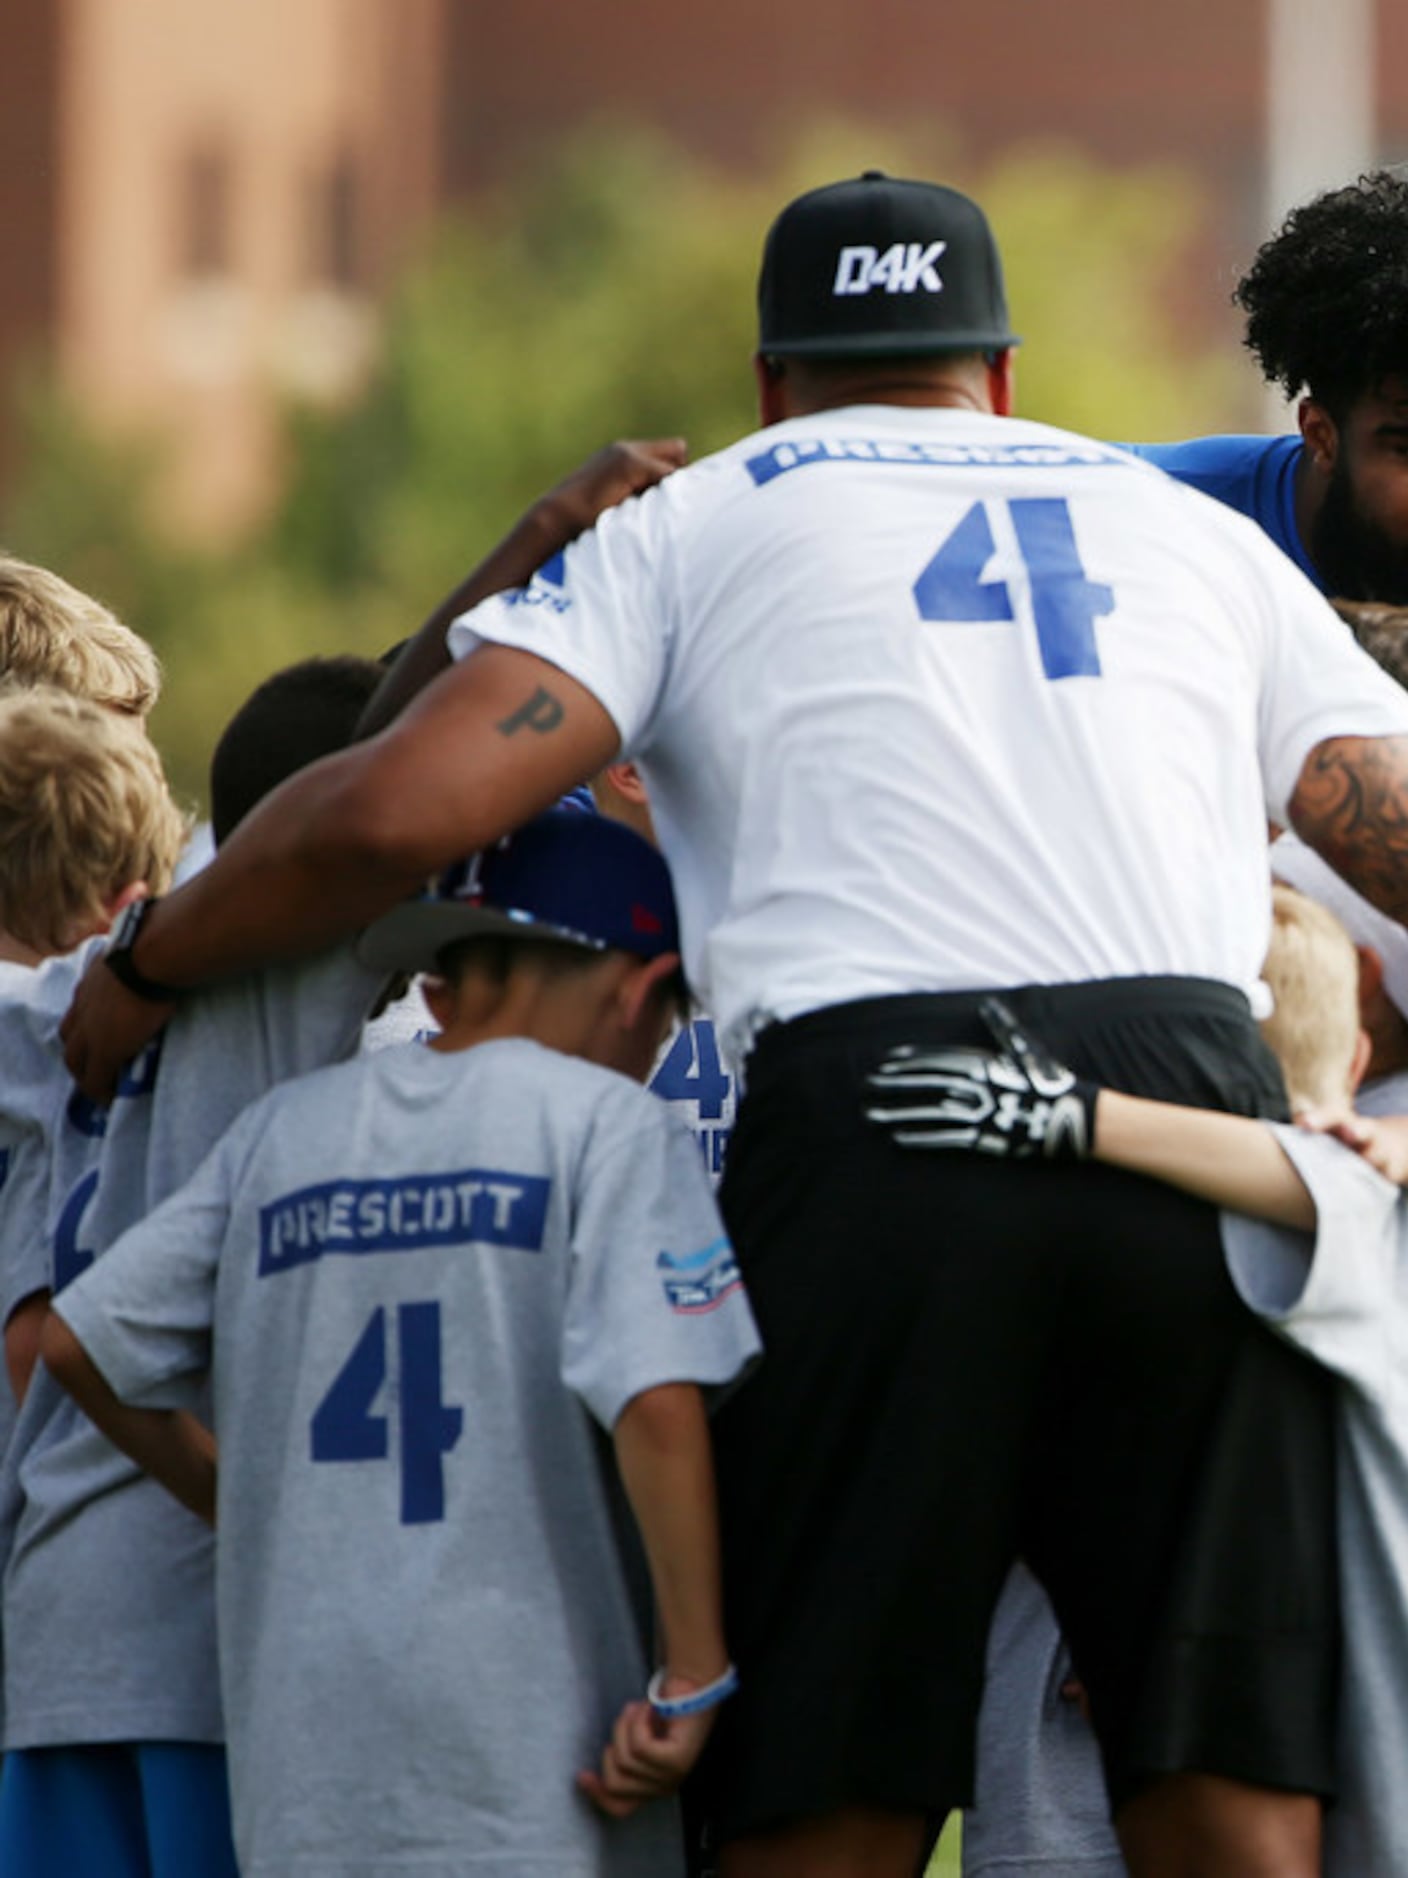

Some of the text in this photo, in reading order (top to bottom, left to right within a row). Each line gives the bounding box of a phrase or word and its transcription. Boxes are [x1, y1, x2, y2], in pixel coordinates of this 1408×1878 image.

[833, 240, 946, 295] D4K
[913, 497, 1115, 681] 4
[270, 1181, 524, 1257] PRESCOTT
[311, 1301, 463, 1525] 4
